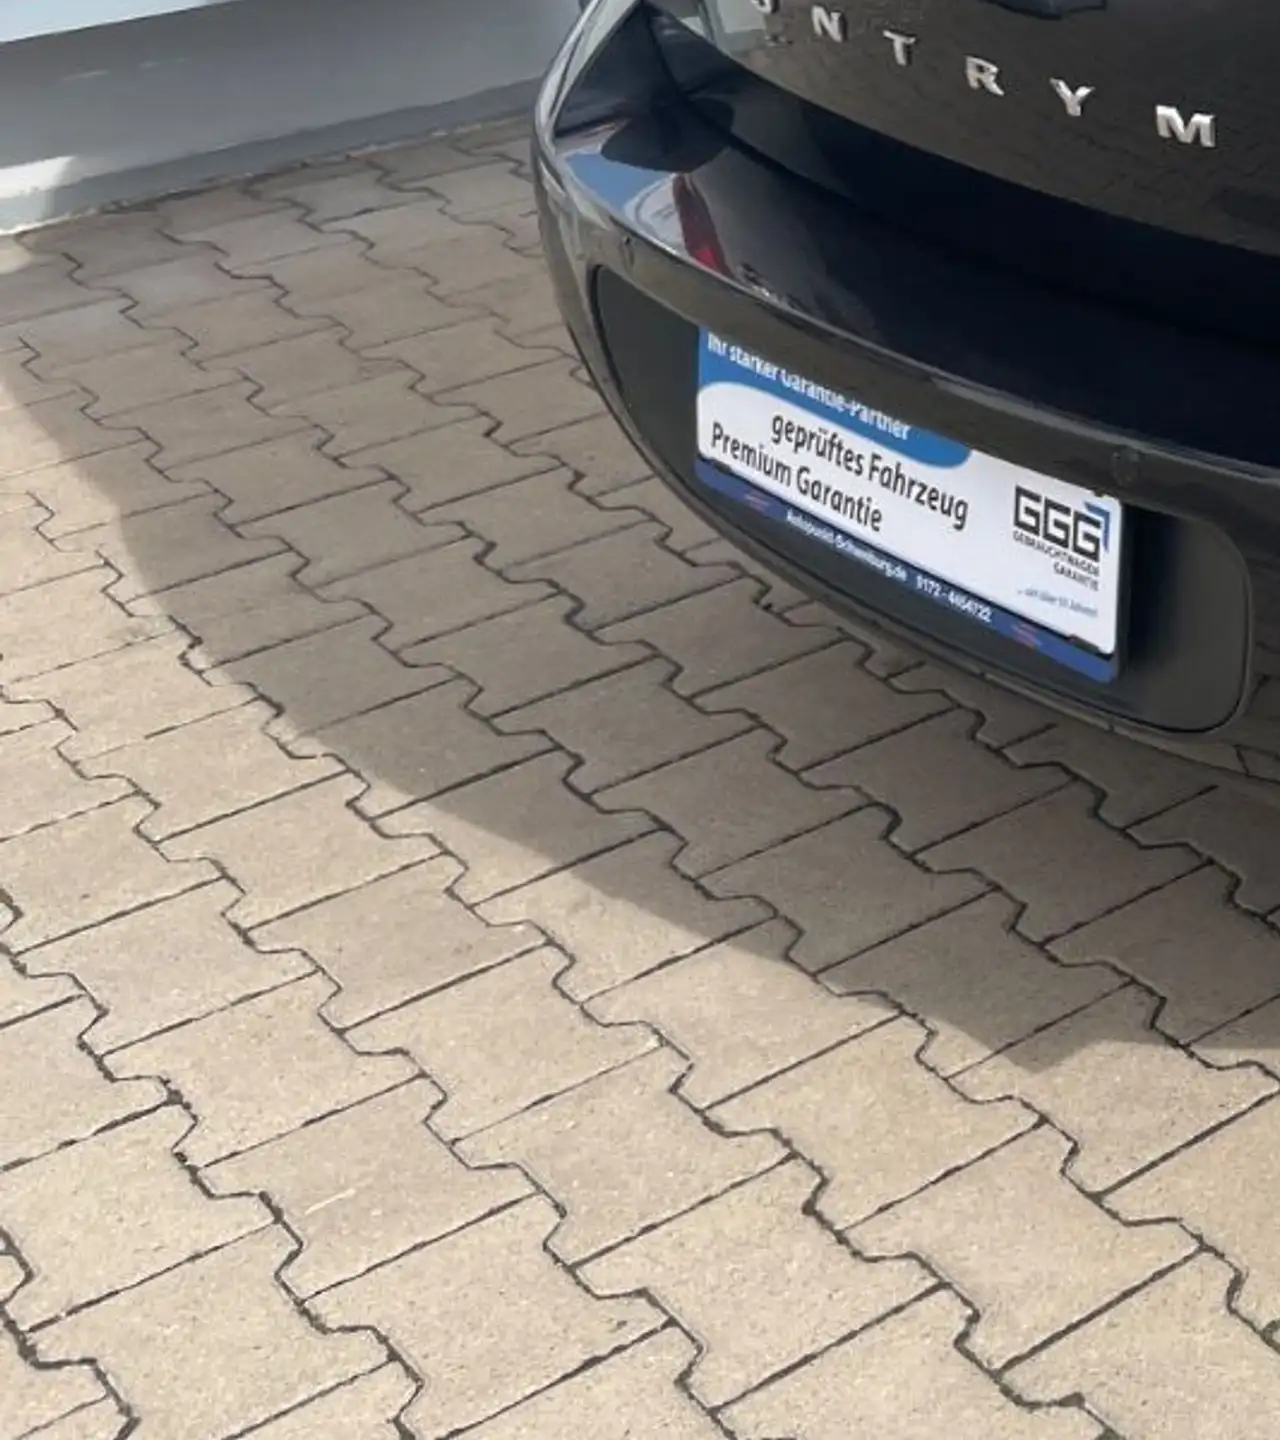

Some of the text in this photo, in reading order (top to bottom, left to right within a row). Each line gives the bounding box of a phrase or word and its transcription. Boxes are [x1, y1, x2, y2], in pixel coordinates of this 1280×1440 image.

[711, 421, 883, 532] Premium Garantie
[771, 414, 969, 531] geprüftes Fahrzeug
[1013, 484, 1101, 563] GGG
